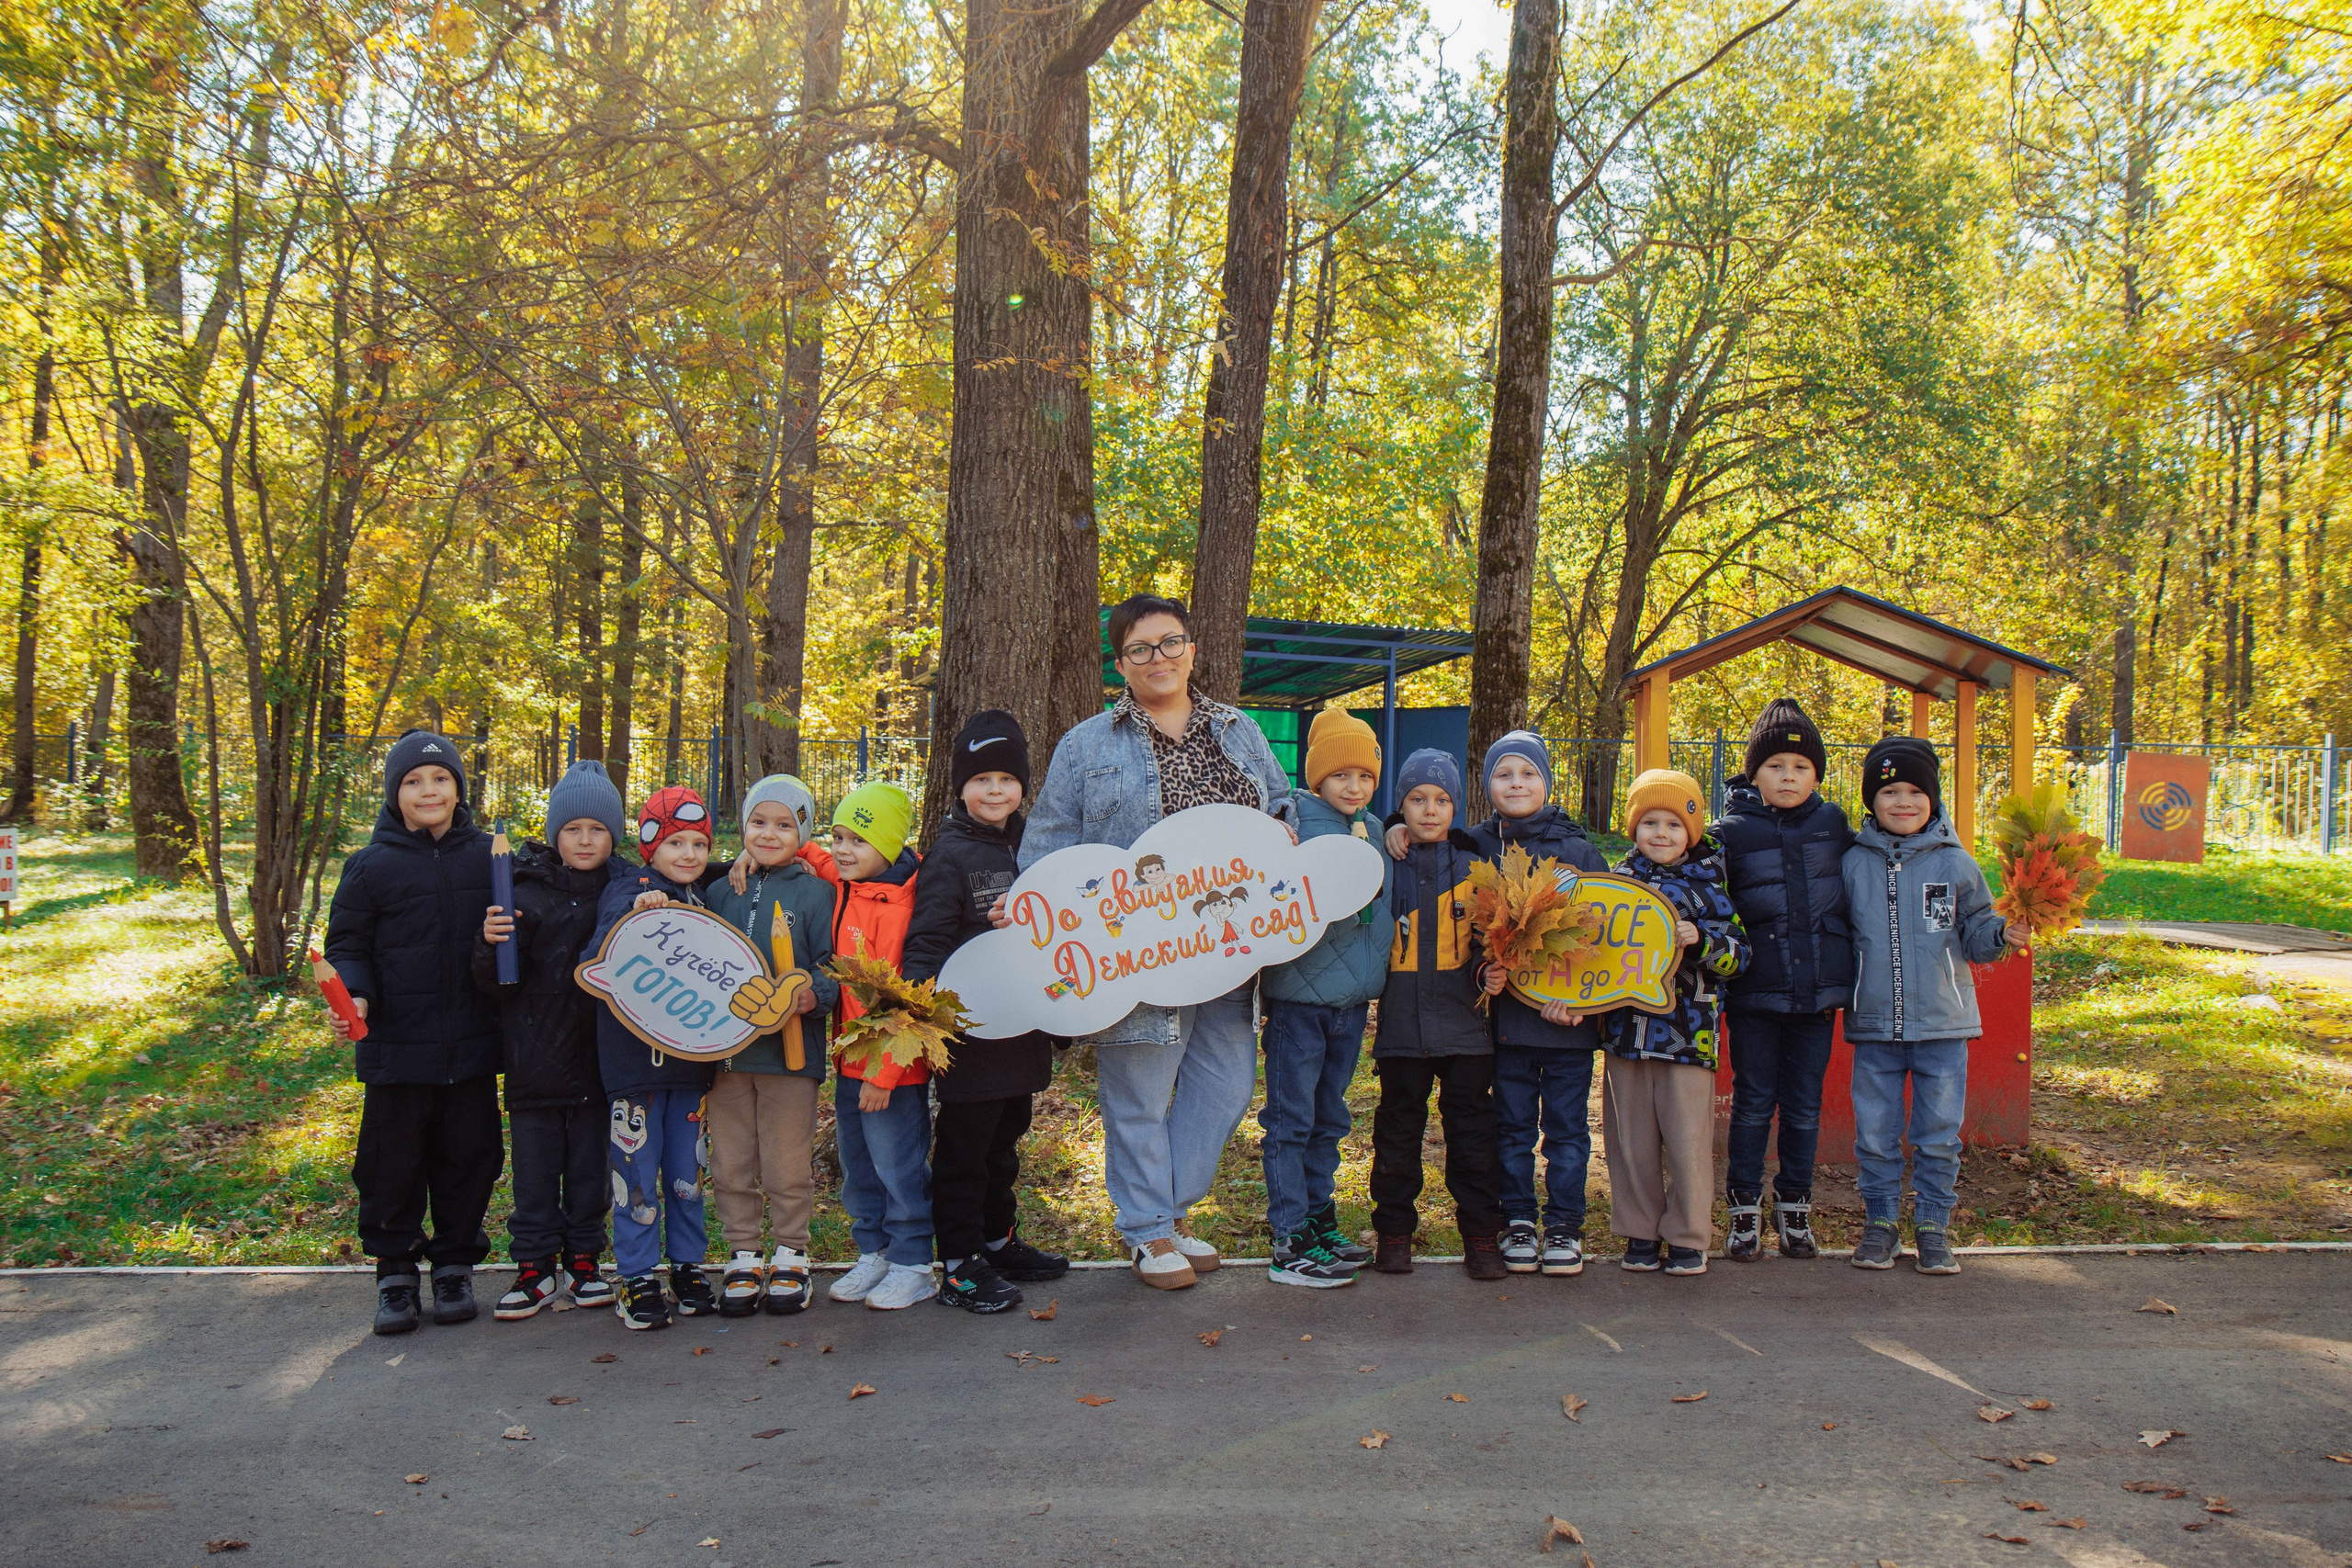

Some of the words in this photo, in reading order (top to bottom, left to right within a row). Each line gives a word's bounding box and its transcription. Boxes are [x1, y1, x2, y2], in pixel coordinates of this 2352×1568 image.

[968, 870, 1015, 891] Urban
[1012, 890, 1082, 950] До
[1098, 857, 1265, 920] свидания,
[642, 920, 685, 951] К
[664, 944, 745, 991] учёбе
[1053, 923, 1216, 999] Детский
[1250, 875, 1319, 944] сад!
[1517, 970, 1544, 987] от
[1578, 969, 1611, 1000] до
[1615, 949, 1660, 987] Я!
[615, 954, 731, 1038] ГОТОВ!
